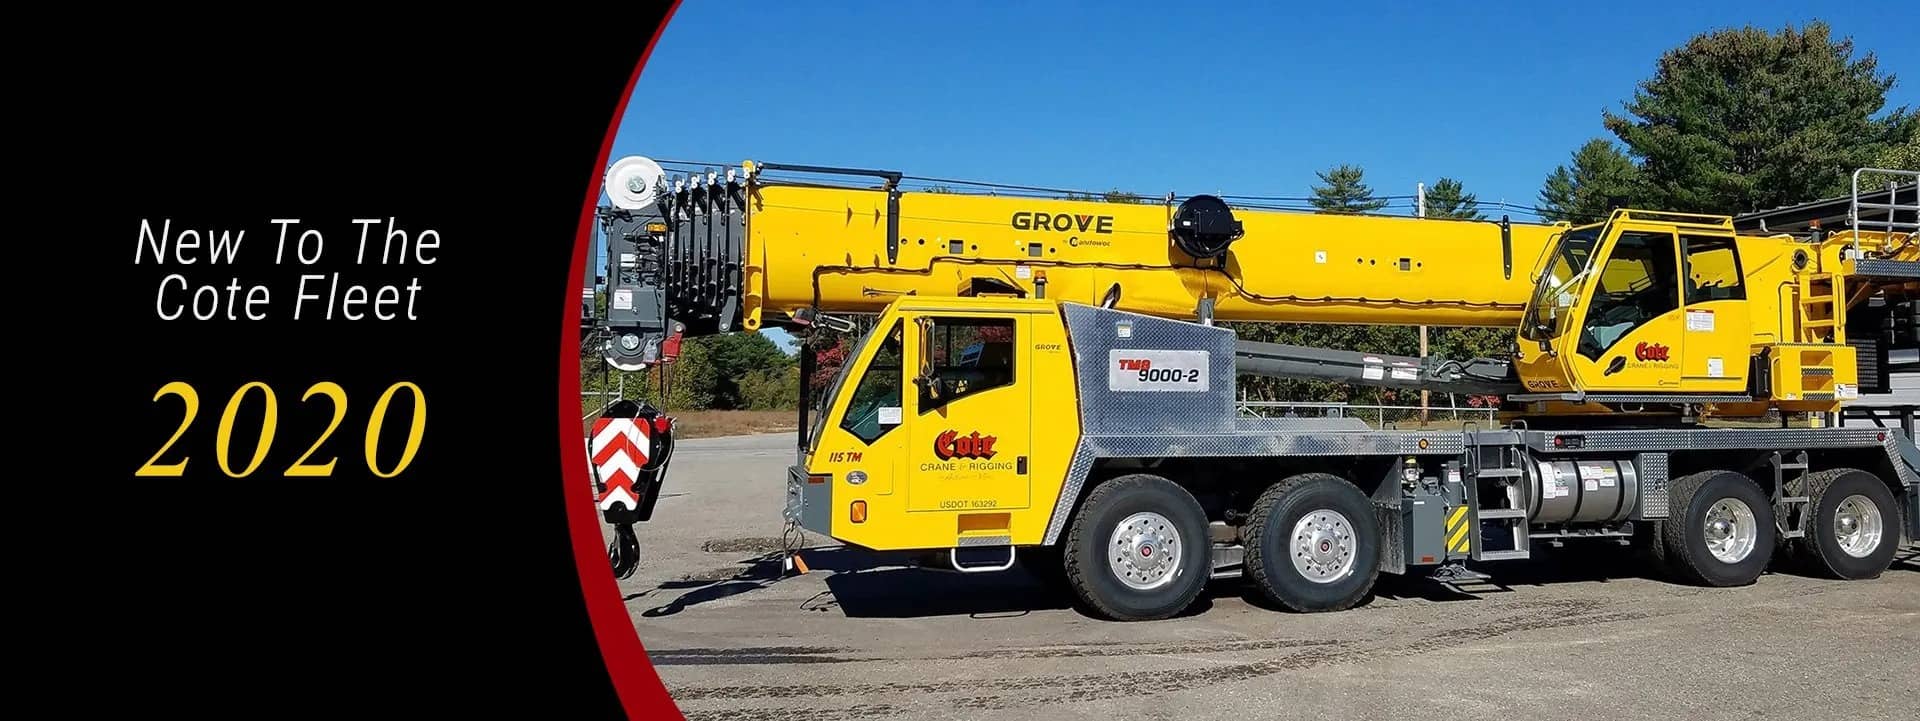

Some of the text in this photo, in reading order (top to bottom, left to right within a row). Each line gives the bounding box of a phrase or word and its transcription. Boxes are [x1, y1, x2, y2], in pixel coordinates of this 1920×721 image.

[1011, 211, 1114, 234] GROVE
[1034, 343, 1062, 351] GROVE
[1138, 368, 1200, 383] 9000-2
[933, 429, 998, 461] Cote
[829, 452, 863, 463] 115 TM
[920, 463, 956, 472] CRANE
[969, 462, 1013, 471] RIGGING
[940, 500, 968, 509] USDOT
